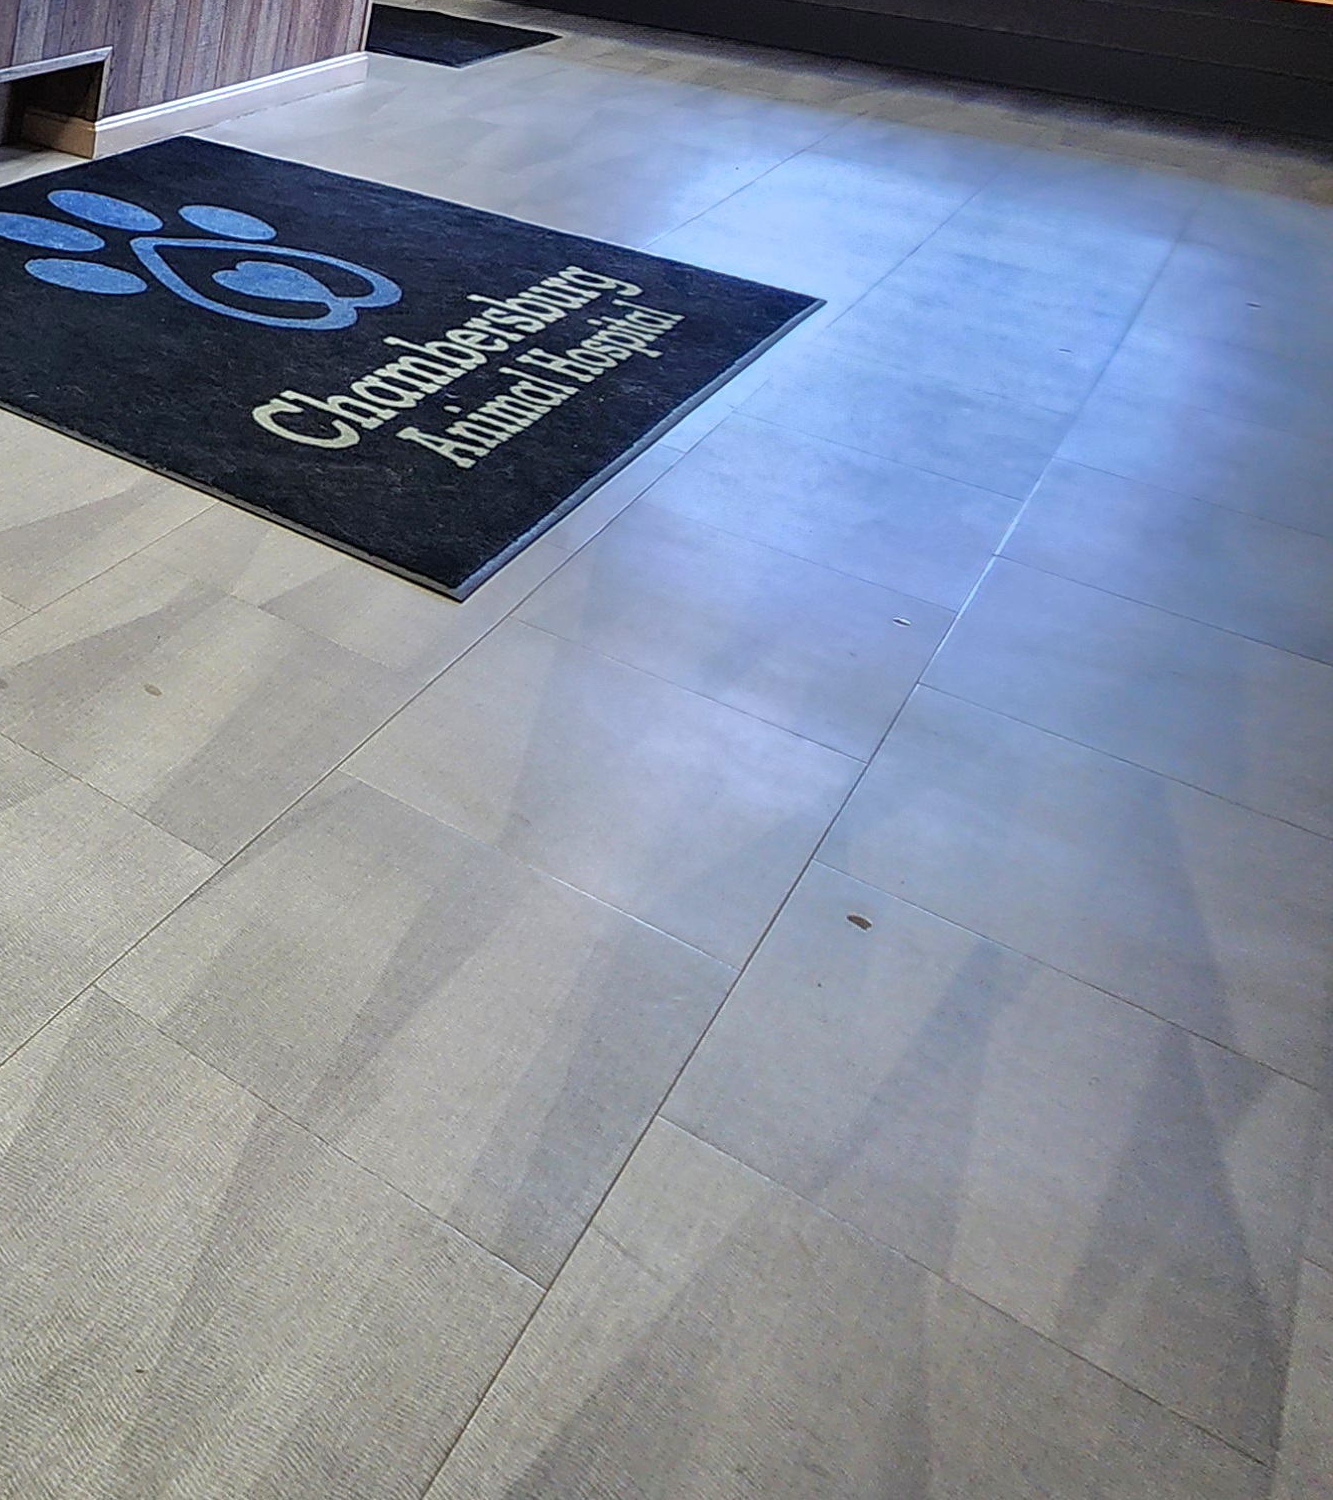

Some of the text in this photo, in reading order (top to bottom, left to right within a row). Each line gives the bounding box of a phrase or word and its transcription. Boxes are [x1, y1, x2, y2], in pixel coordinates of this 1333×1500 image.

[252, 265, 644, 450] Chambersburg
[395, 299, 685, 469] Animal Hospital
